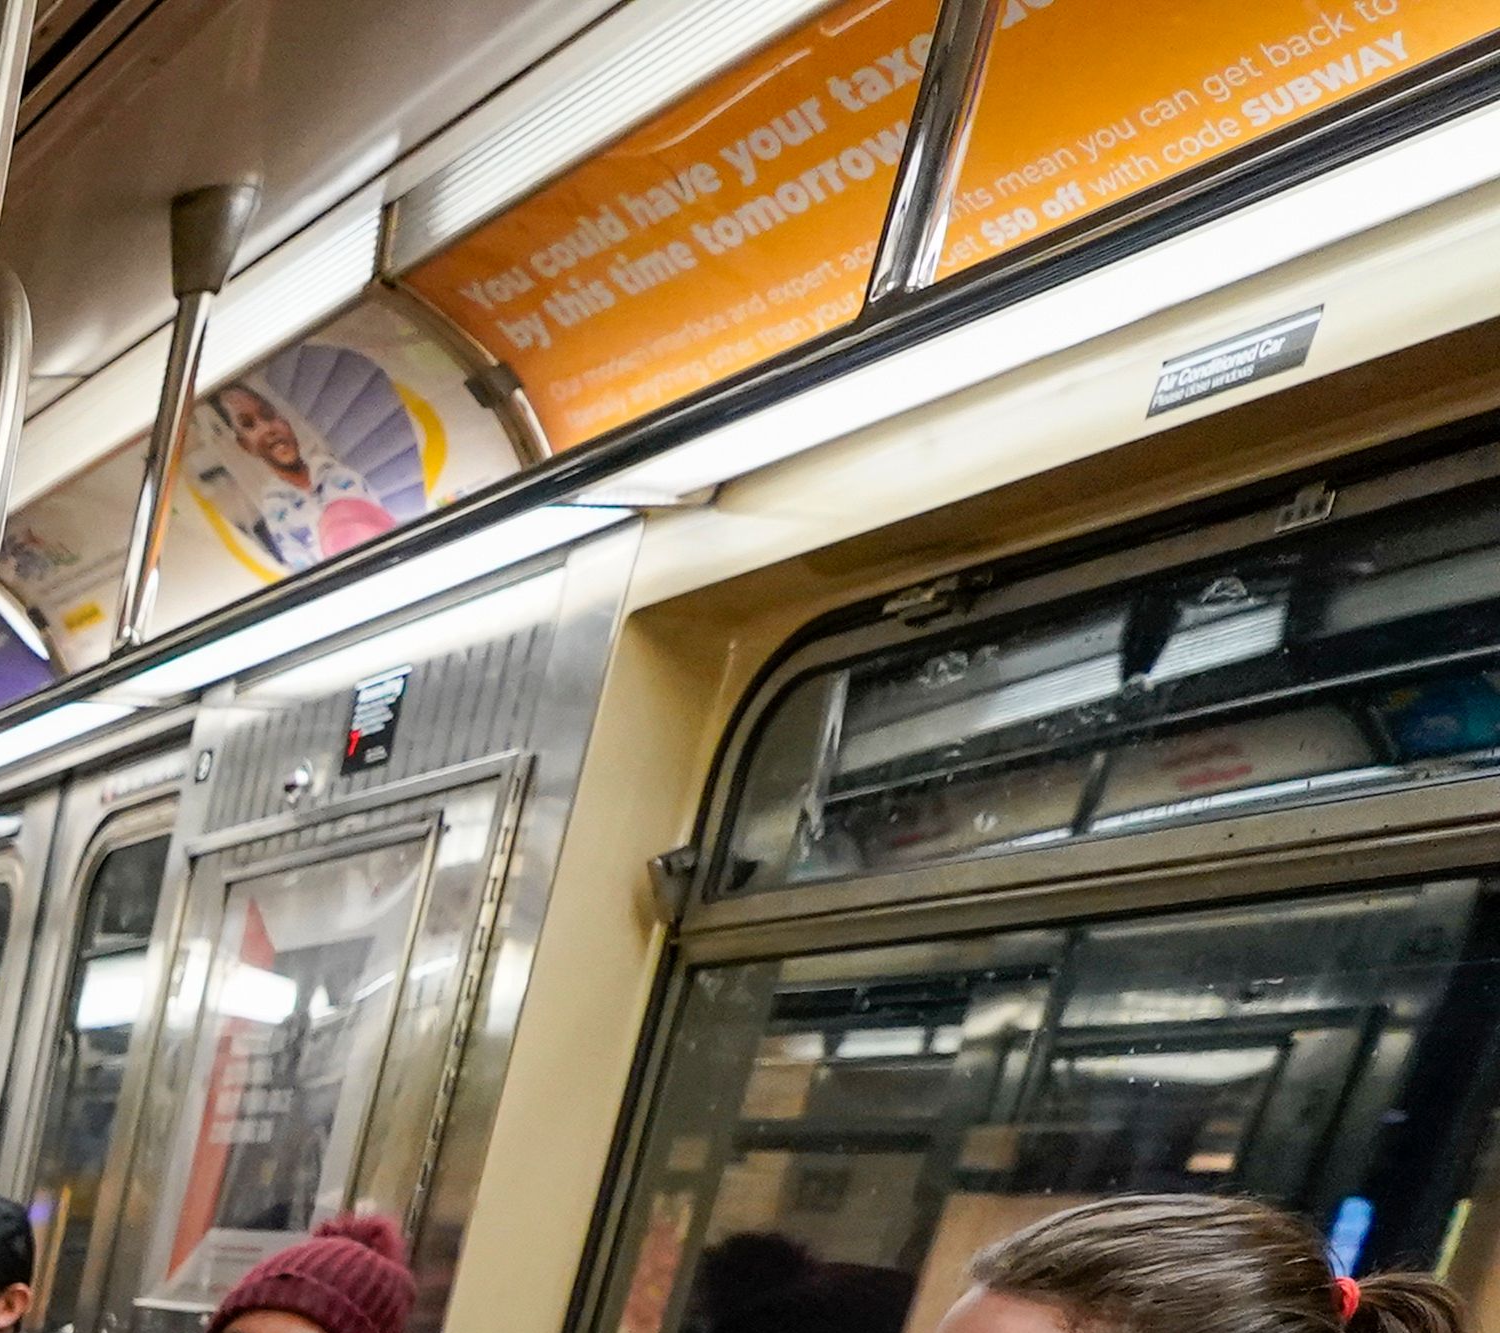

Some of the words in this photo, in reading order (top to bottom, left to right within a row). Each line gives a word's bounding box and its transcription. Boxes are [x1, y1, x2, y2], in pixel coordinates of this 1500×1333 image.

[980, 207, 1038, 247] $50
[1042, 180, 1087, 219] off
[1088, 152, 1159, 196] with
[1160, 116, 1241, 161] code
[1241, 31, 1408, 127] SUBWAY
[995, 146, 1078, 198] mean
[1071, 115, 1137, 162] you
[1139, 87, 1200, 130] can
[1203, 56, 1263, 103] get
[1259, 12, 1356, 68] back
[1354, 0, 1399, 23] to
[459, 266, 537, 311] You
[530, 211, 628, 279] could
[618, 158, 723, 237] have
[719, 96, 829, 186] your
[497, 312, 552, 349] by
[543, 276, 617, 328] this
[609, 238, 699, 293] time
[691, 119, 909, 257] tomorrow
[767, 261, 842, 306] expert
[1158, 374, 1181, 393] Air
[1178, 343, 1260, 386] Conditioned
[1259, 337, 1286, 358] Car
